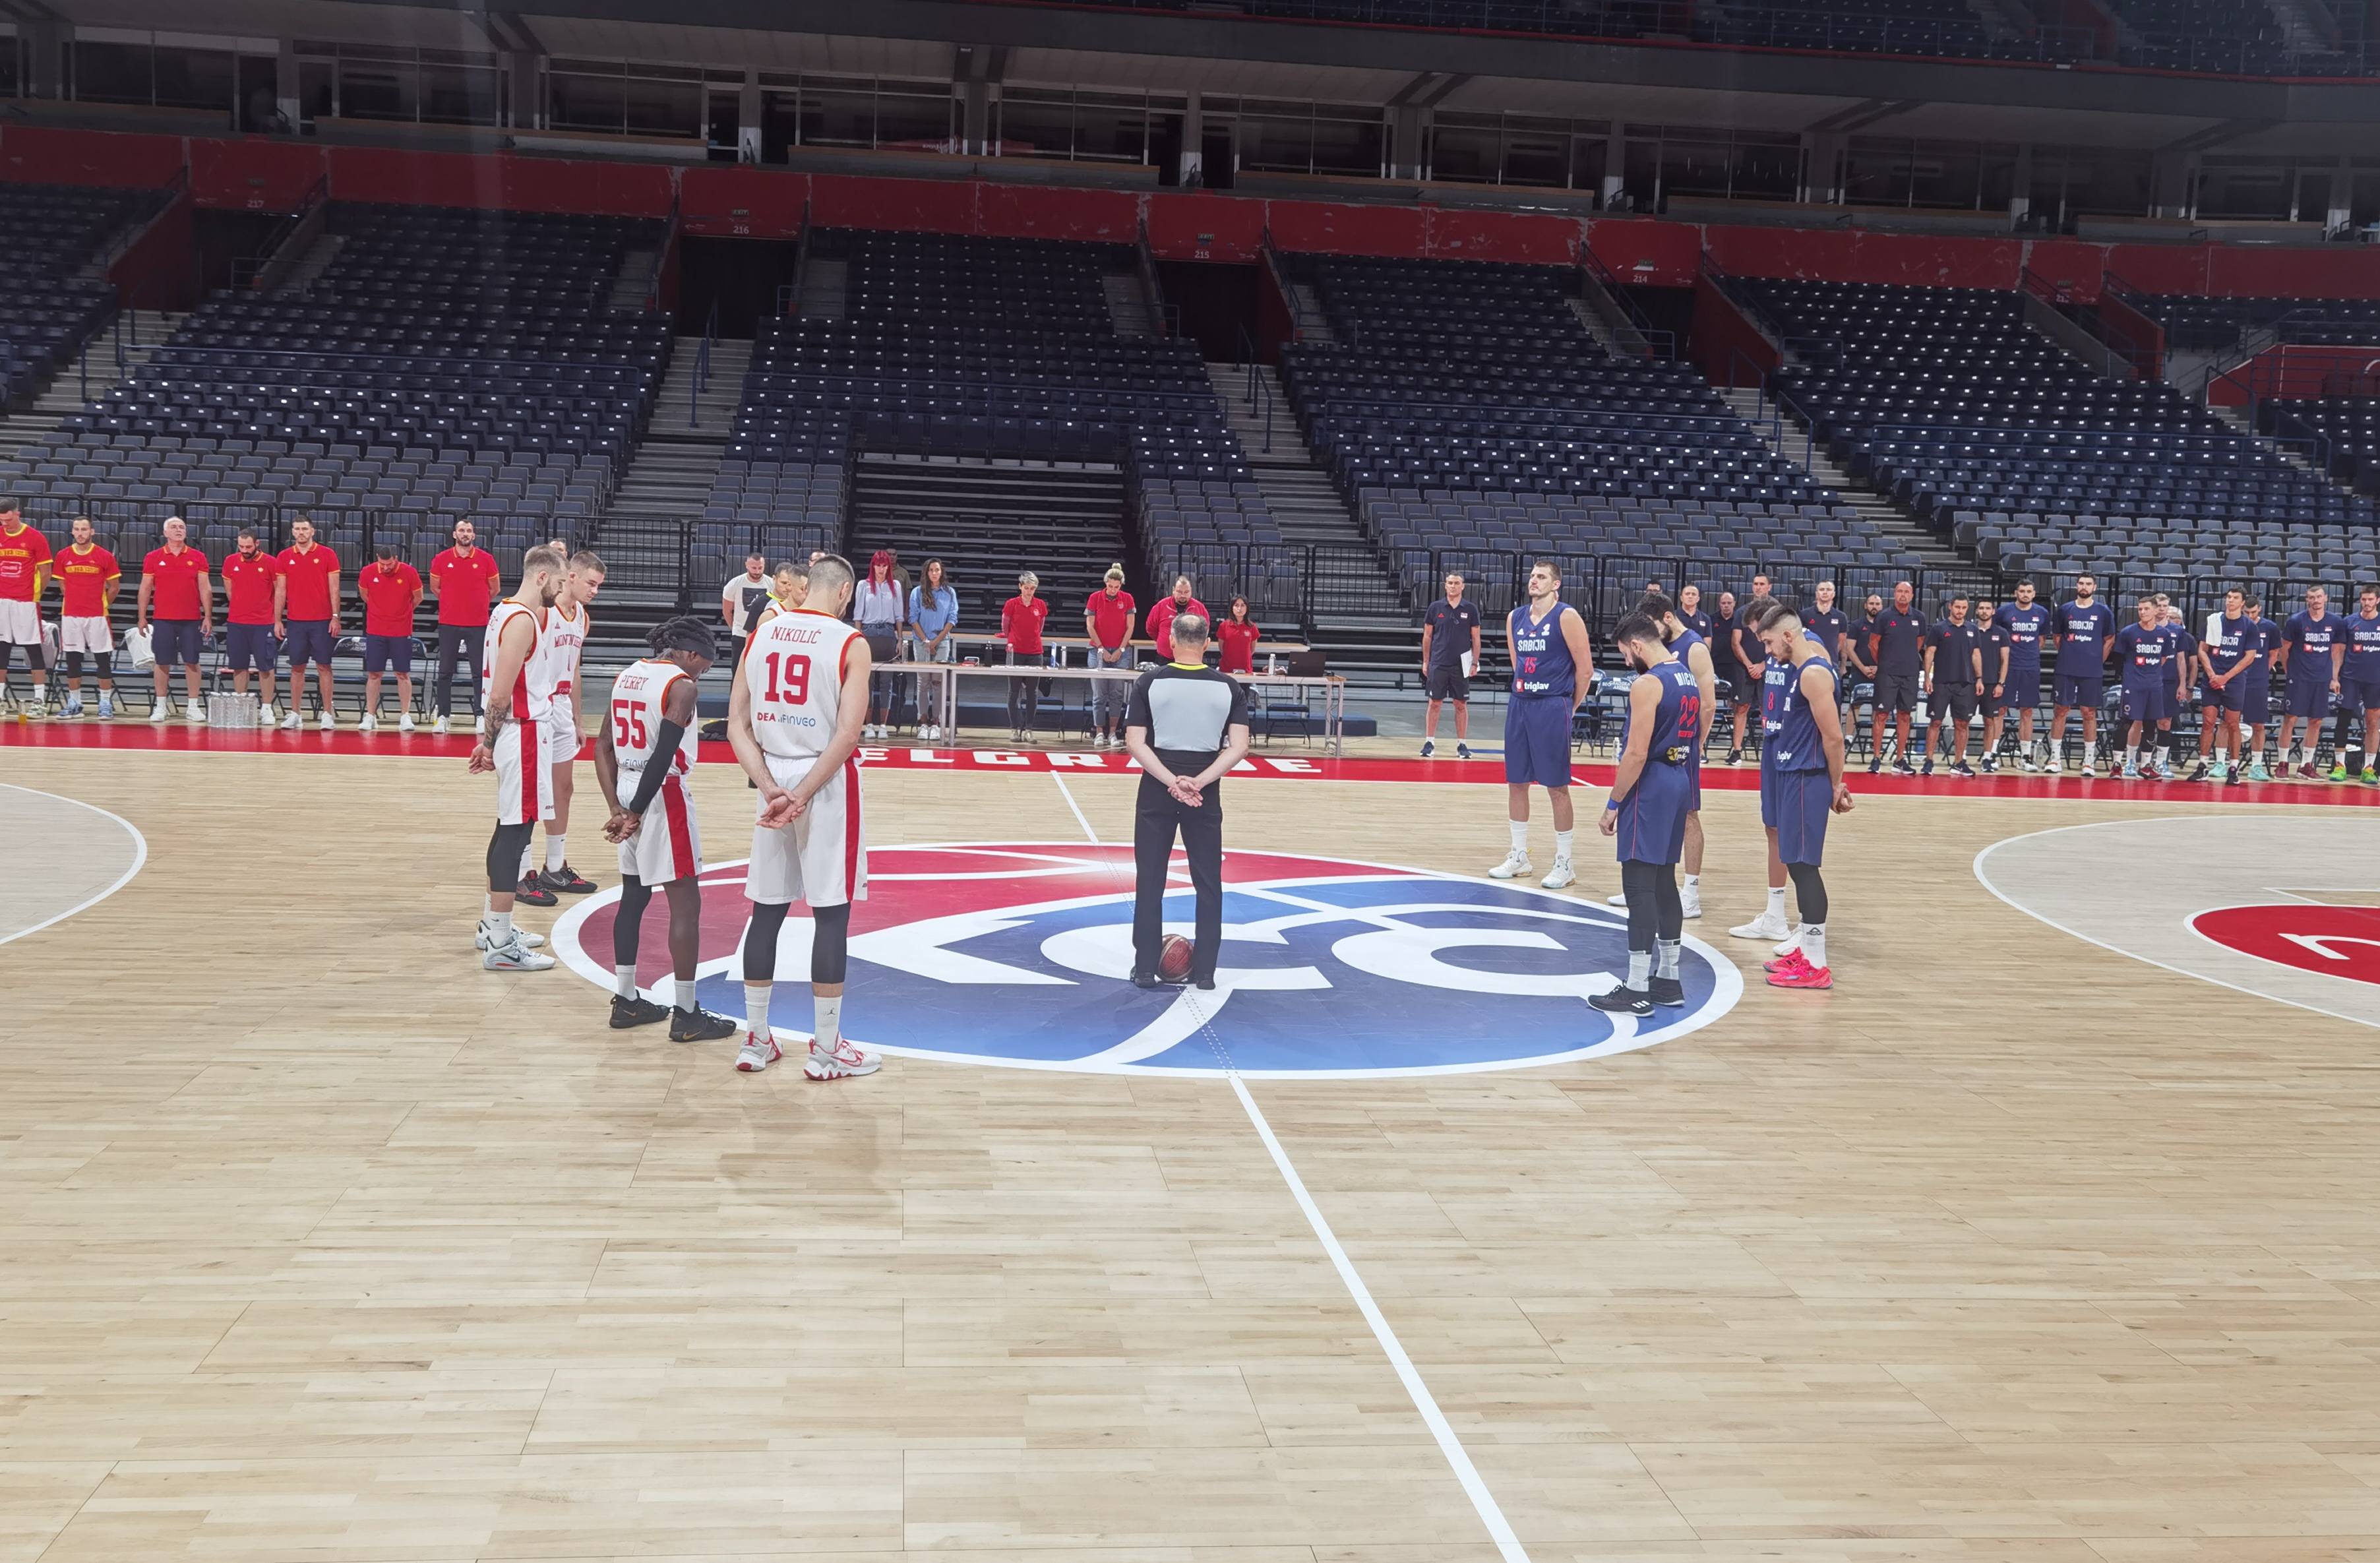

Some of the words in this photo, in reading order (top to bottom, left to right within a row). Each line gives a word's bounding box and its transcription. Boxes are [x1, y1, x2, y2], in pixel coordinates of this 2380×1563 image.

[733, 226, 750, 234] 216
[2012, 623, 2037, 631] SRBIJA
[2068, 621, 2094, 630] SRBIJA
[770, 626, 822, 644] NIKOLIĆ
[2220, 636, 2239, 646] BIJA
[2305, 633, 2330, 642] SRBIJA
[2354, 632, 2380, 641] SRBIJA
[1517, 639, 1546, 652] SRBIJA
[2136, 644, 2162, 654] SRBIJA
[1524, 657, 1537, 673] 15
[619, 675, 649, 690] PERRY
[764, 652, 812, 706] 19
[1765, 670, 1785, 686] SRBIJA
[1523, 681, 1550, 692] triglav
[1768, 691, 1774, 710] 8
[782, 714, 816, 727] FINVEO
[1679, 694, 1699, 738] 22
[613, 699, 646, 749] 55
